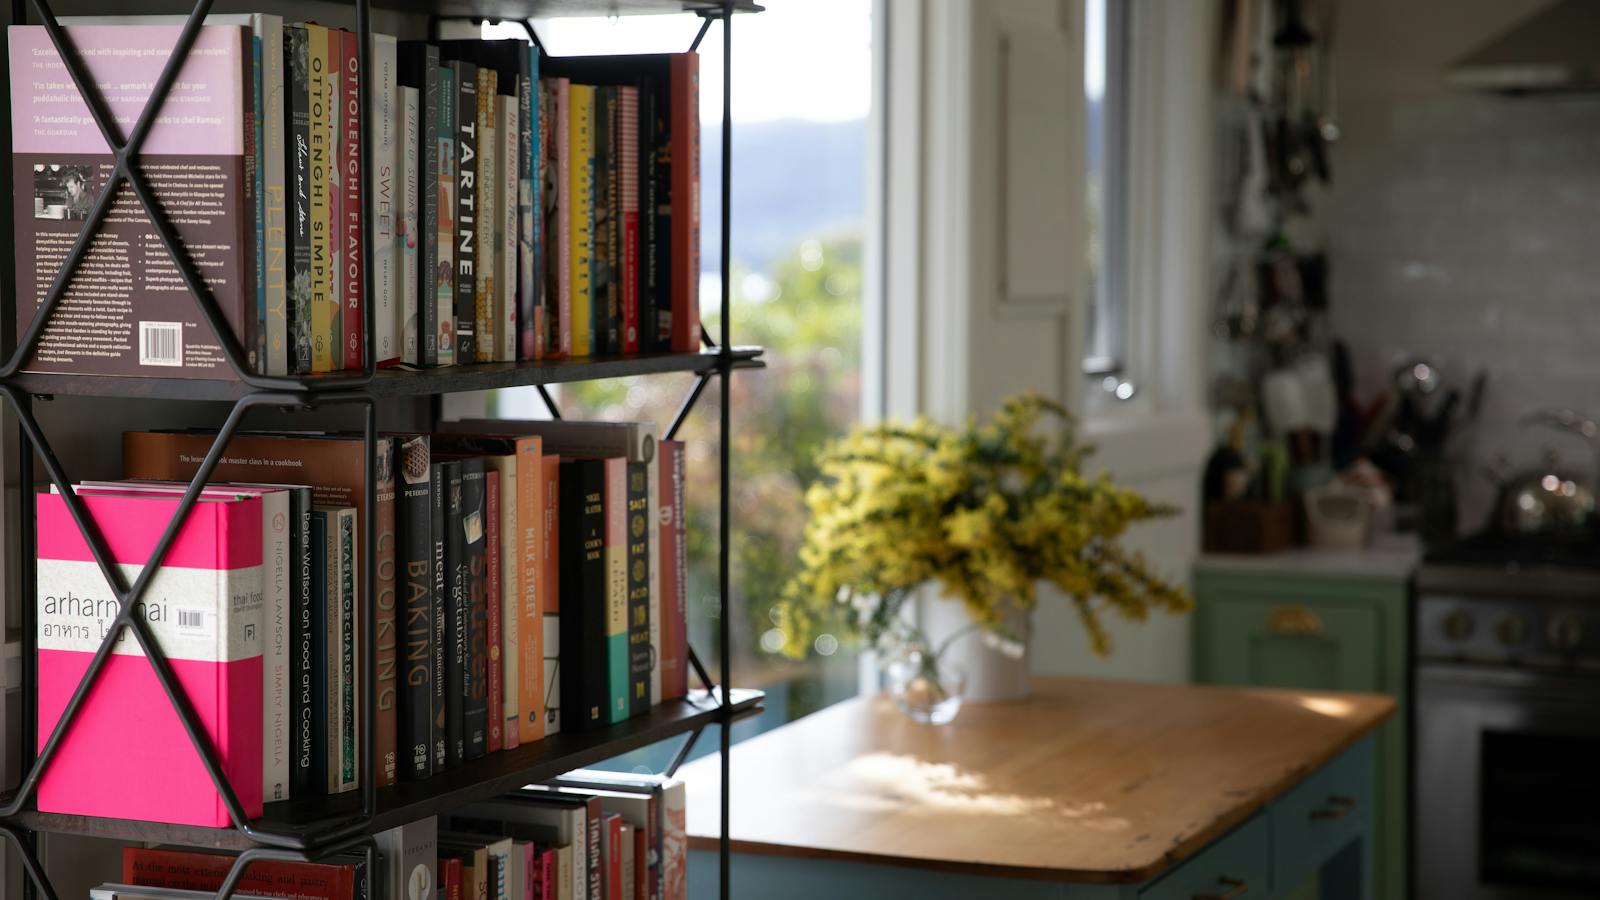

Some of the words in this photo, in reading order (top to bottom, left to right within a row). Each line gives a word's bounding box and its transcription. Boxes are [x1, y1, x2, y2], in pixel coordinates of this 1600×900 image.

[313, 57, 324, 207] OTTOLENGHI
[348, 57, 359, 199] OTTOLENGHI
[380, 164, 391, 239] SWEET
[459, 121, 476, 277] TARTINE
[267, 185, 285, 319] PLENTY
[314, 221, 324, 303] SIMPLE
[349, 212, 359, 308] FLAVOUR
[302, 512, 311, 549] Peter
[525, 527, 536, 562] MILK
[275, 541, 284, 595] NIGELLA
[302, 552, 311, 606] Watson
[343, 543, 351, 590] TABLE
[435, 541, 445, 592] meat
[525, 567, 536, 619] STREET
[44, 592, 118, 618] arharn
[137, 598, 168, 622] hai
[233, 592, 250, 605] thai
[302, 609, 310, 629] on
[375, 528, 396, 713] COOKING
[407, 558, 429, 687] BAKING
[451, 561, 465, 665] vegetables
[274, 598, 284, 657] LAWSON
[302, 632, 311, 671] Food
[344, 598, 352, 674] ORCHARD
[436, 607, 444, 646] Kitchen
[274, 664, 284, 708] SIMPLY
[302, 673, 311, 704] and
[436, 647, 444, 697] Education
[274, 712, 283, 767] NIGELLA
[300, 706, 311, 769] Cooking
